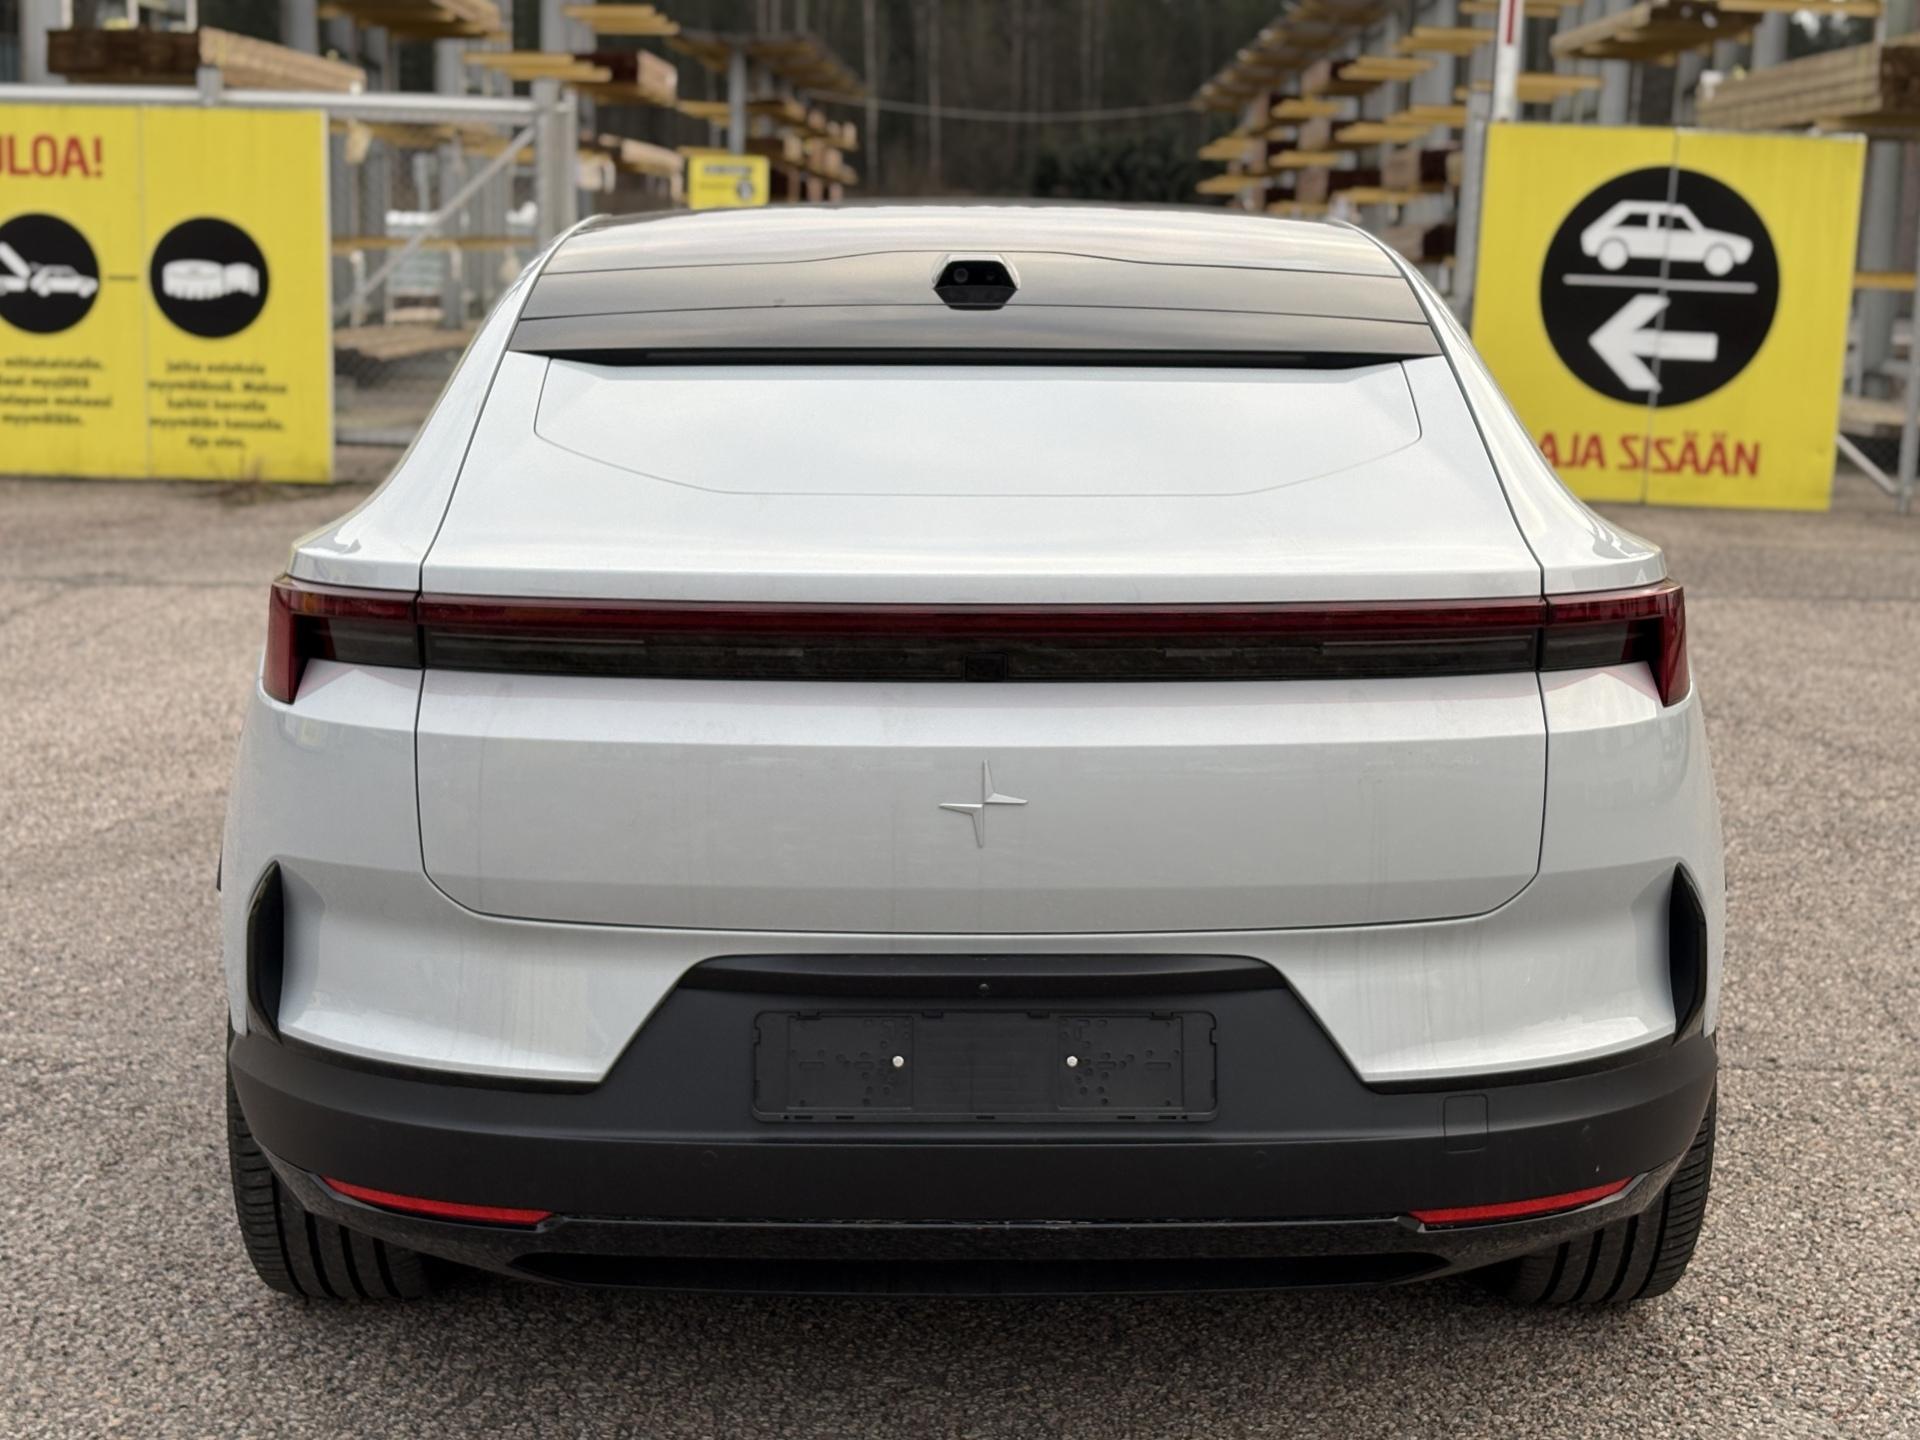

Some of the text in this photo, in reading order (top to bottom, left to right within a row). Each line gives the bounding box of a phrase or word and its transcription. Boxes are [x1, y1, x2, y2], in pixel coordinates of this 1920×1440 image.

[0, 135, 102, 178] LOA!
[1538, 431, 1760, 476] AJA SISÄÄN
